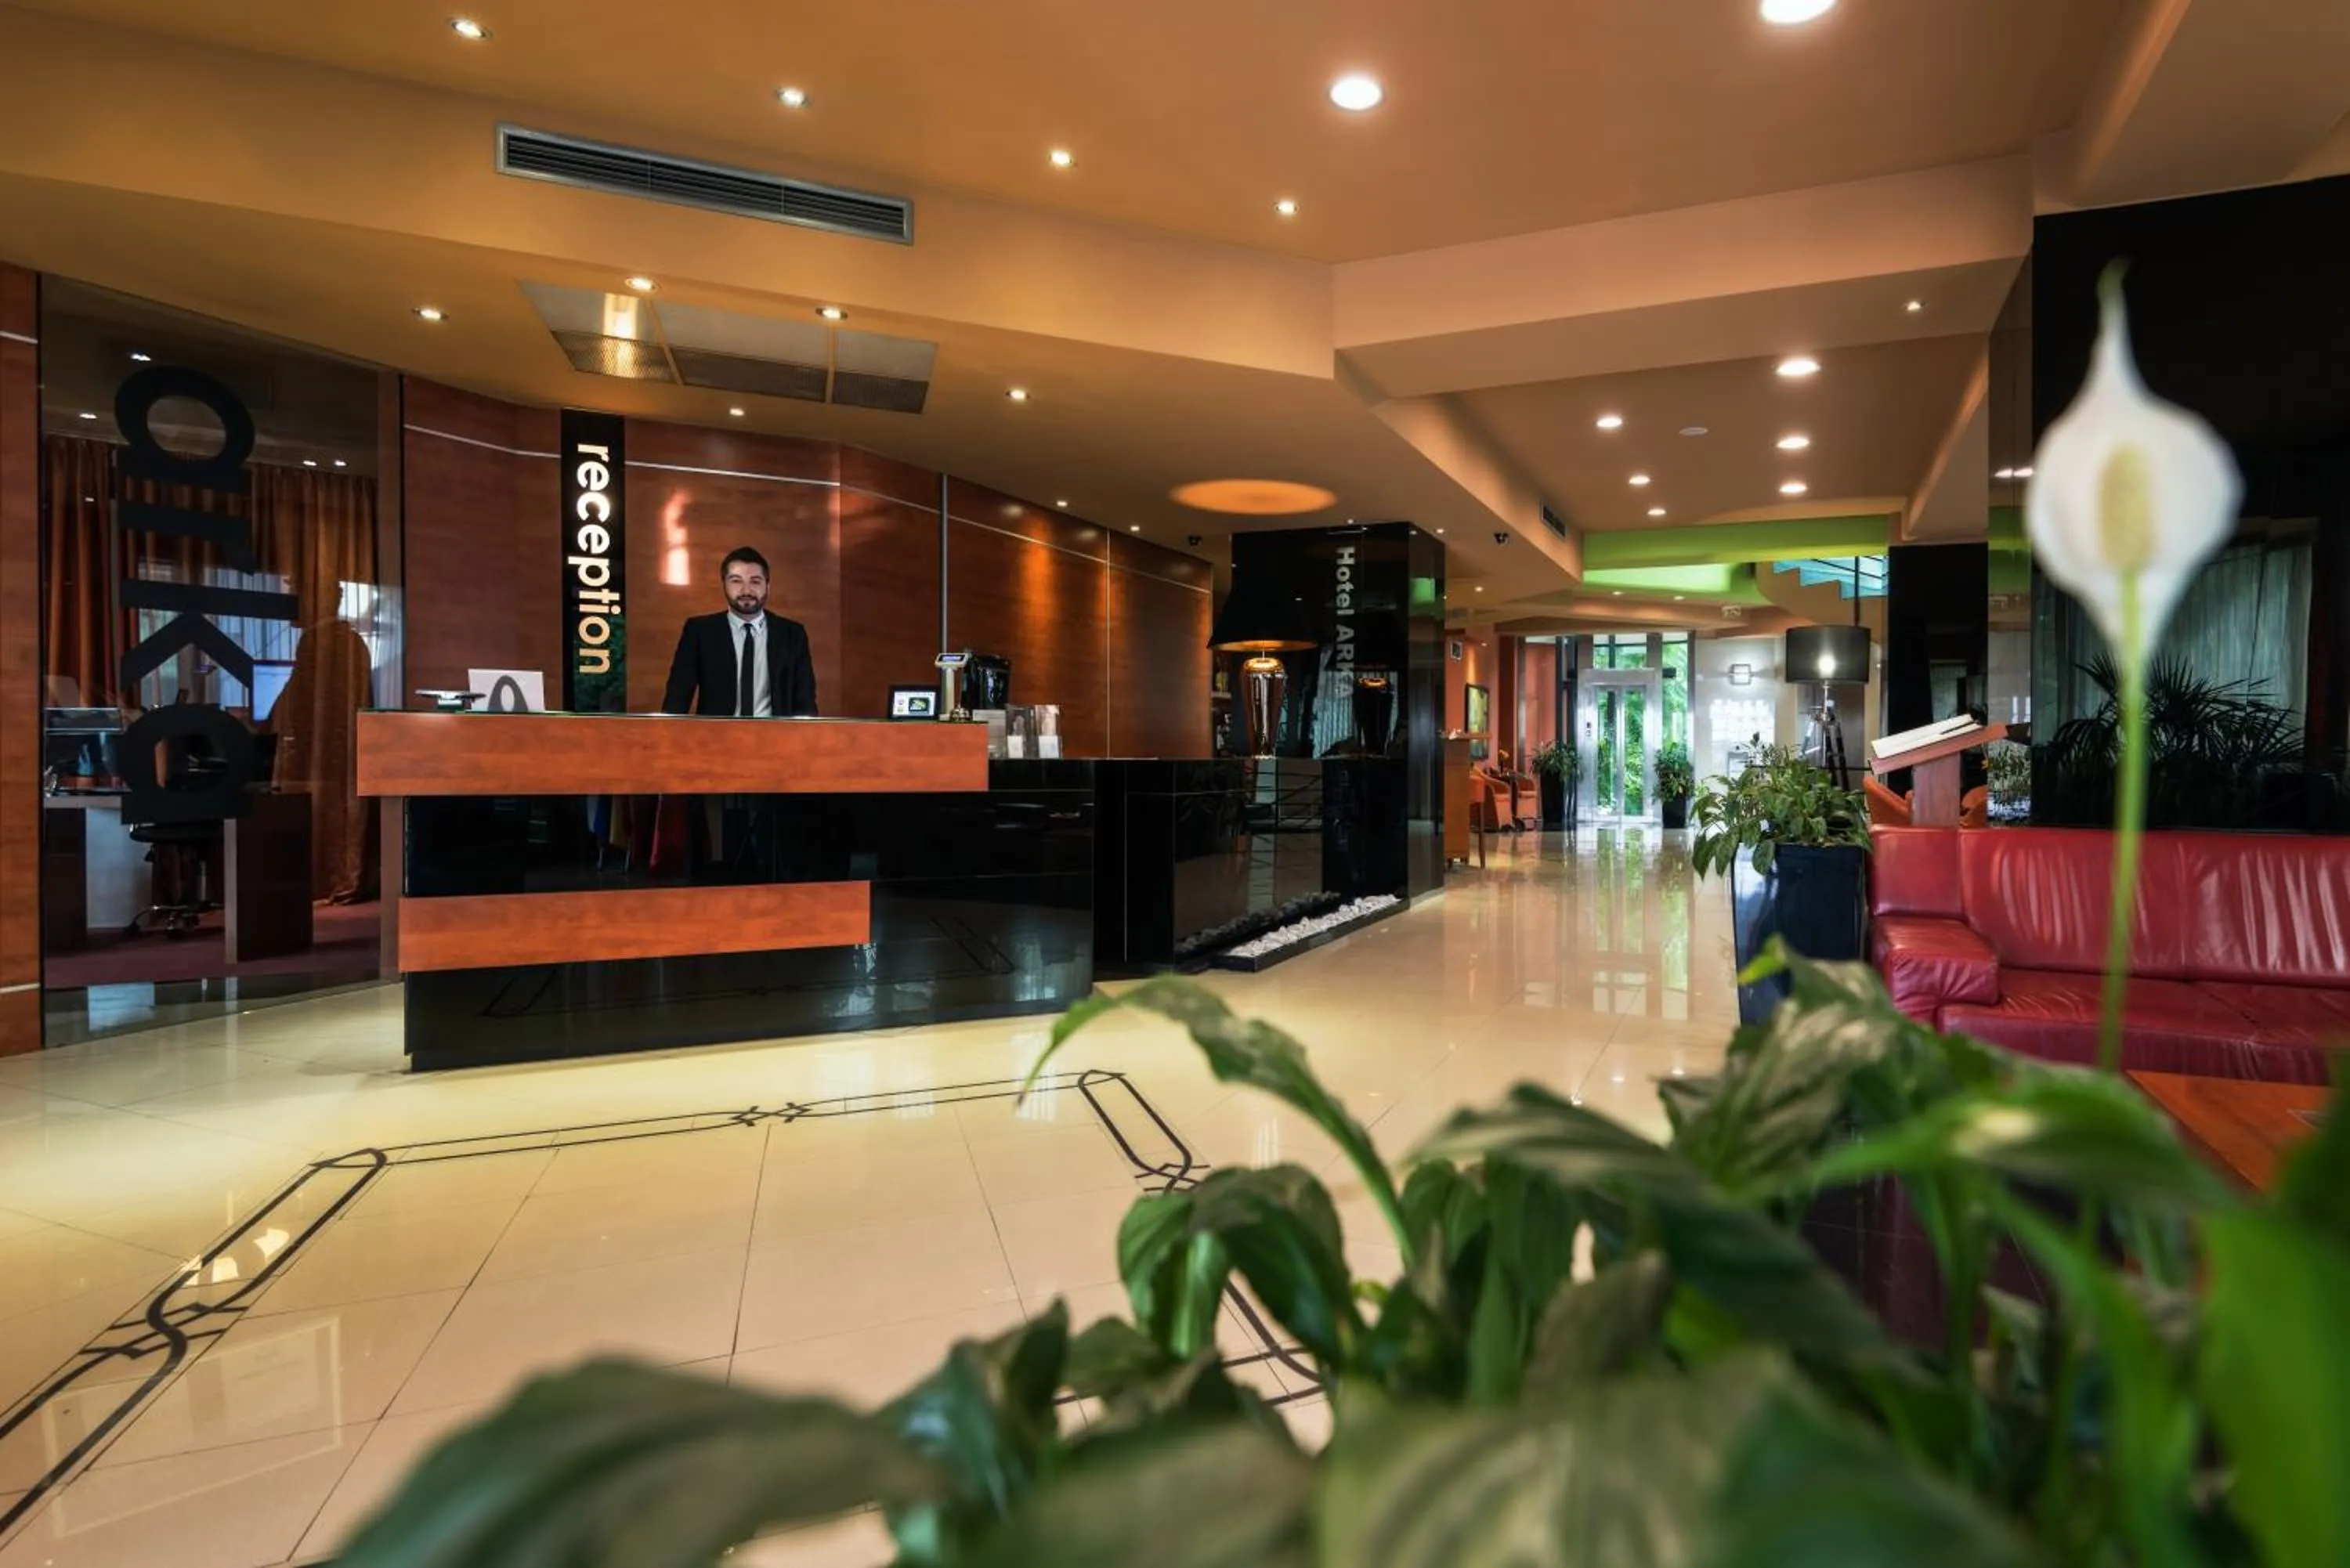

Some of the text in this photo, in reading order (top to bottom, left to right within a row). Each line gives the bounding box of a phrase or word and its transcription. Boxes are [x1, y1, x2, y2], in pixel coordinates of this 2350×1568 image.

[568, 443, 621, 673] reception
[1336, 547, 1354, 699] Hotel ARKA
